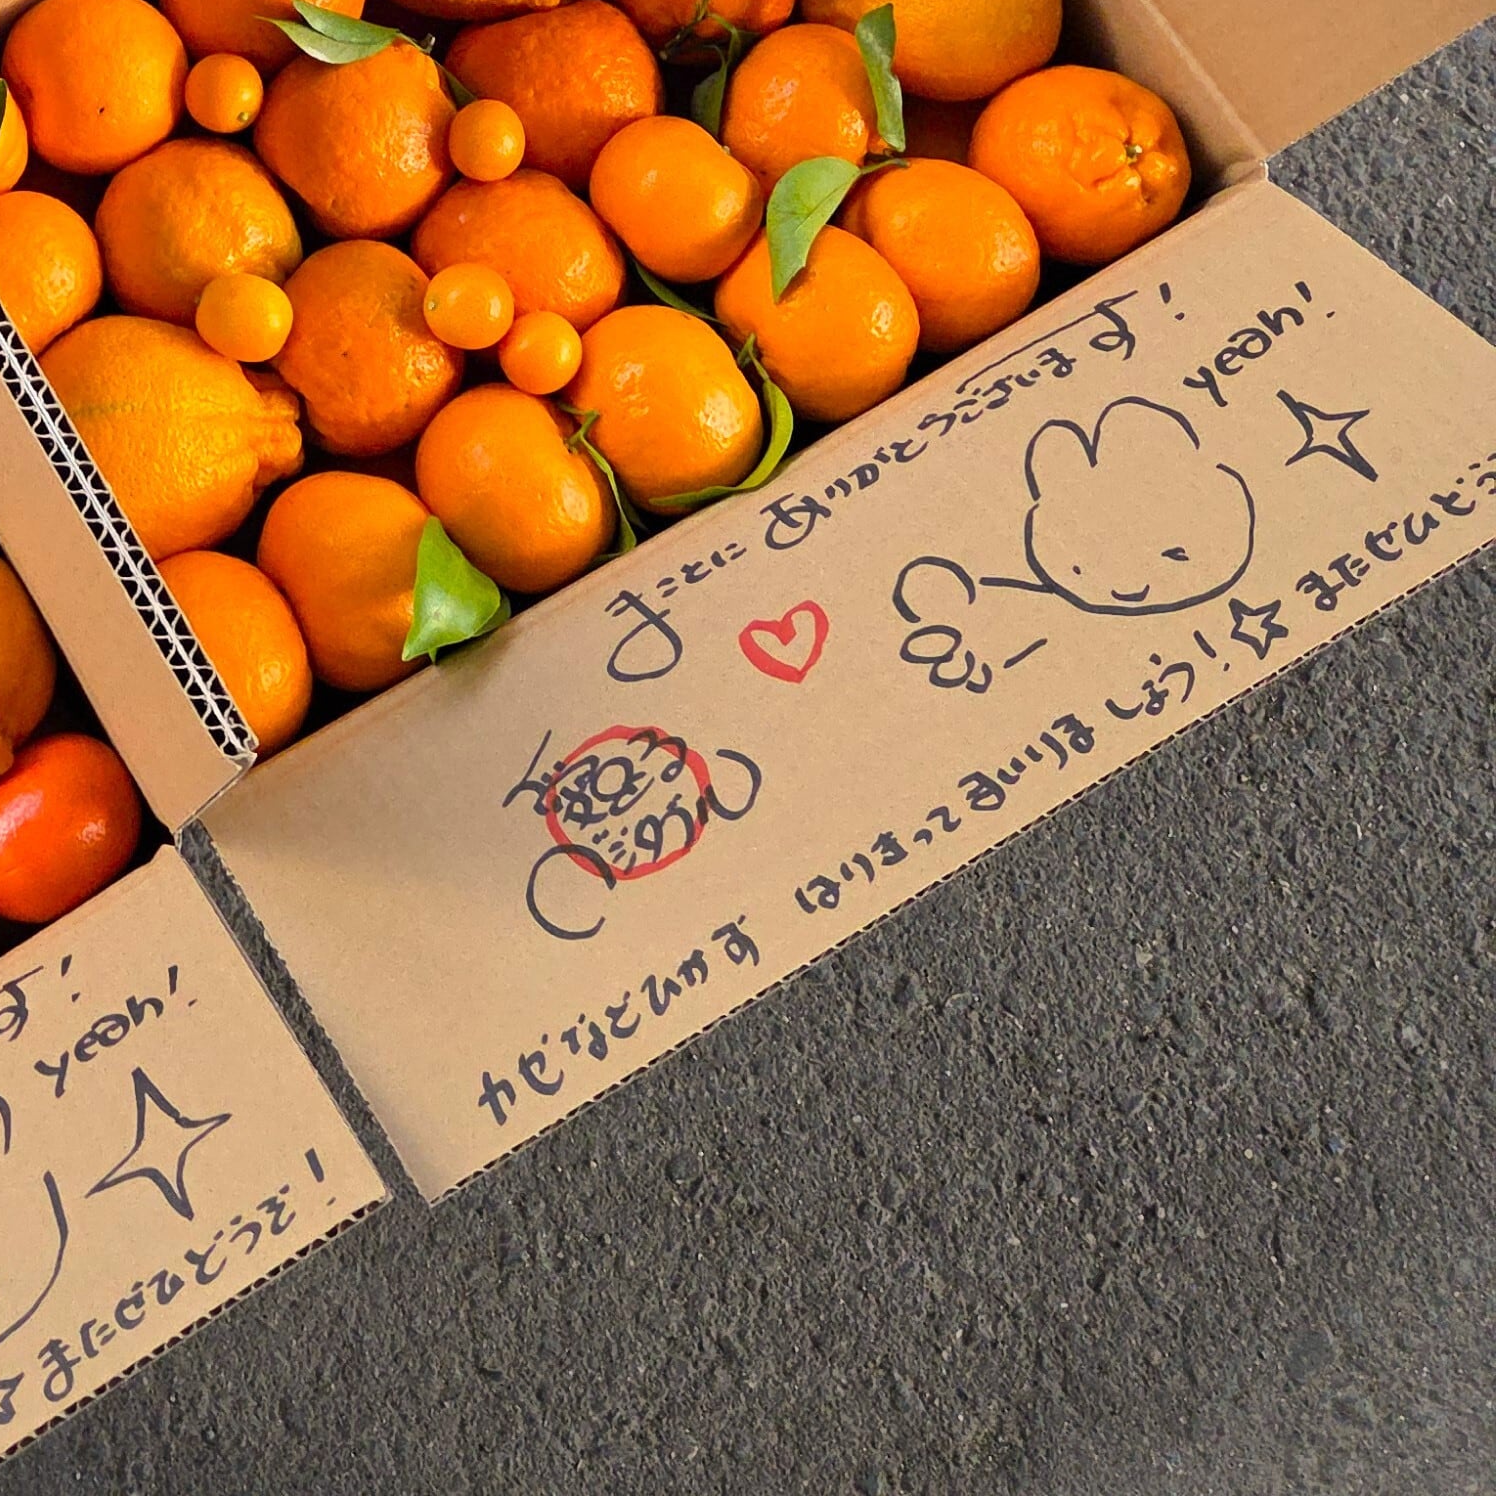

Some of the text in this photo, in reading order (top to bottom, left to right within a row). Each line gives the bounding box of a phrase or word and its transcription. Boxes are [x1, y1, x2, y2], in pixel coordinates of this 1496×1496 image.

[1183, 281, 1336, 407] yeah!
[1295, 451, 1496, 611] またぜひどう
[34, 965, 198, 1096] yeah!
